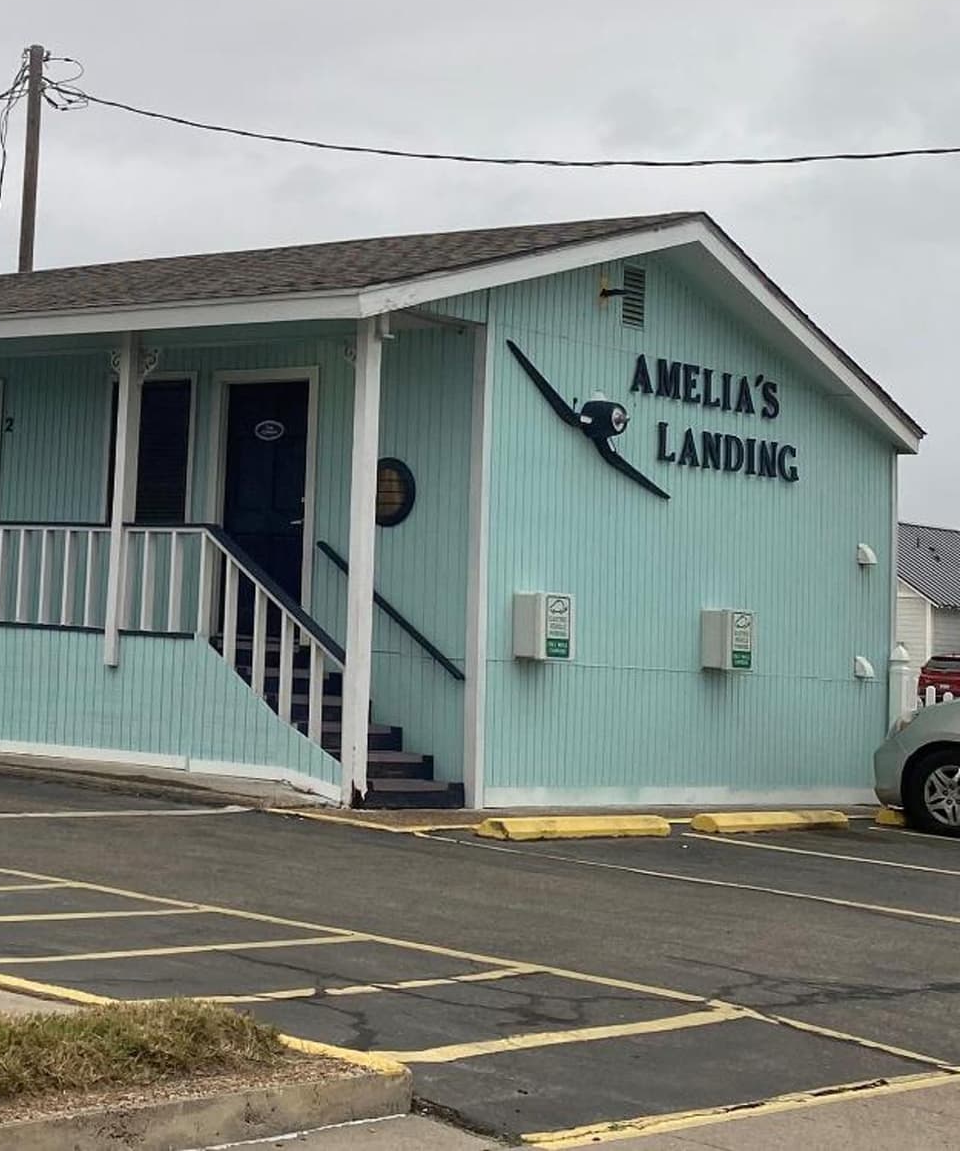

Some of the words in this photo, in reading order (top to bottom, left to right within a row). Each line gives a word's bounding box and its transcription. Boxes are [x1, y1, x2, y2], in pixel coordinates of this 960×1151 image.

[630, 353, 780, 419] AMELIA'S
[4, 417, 14, 433] 2
[657, 421, 800, 483] LANDING
